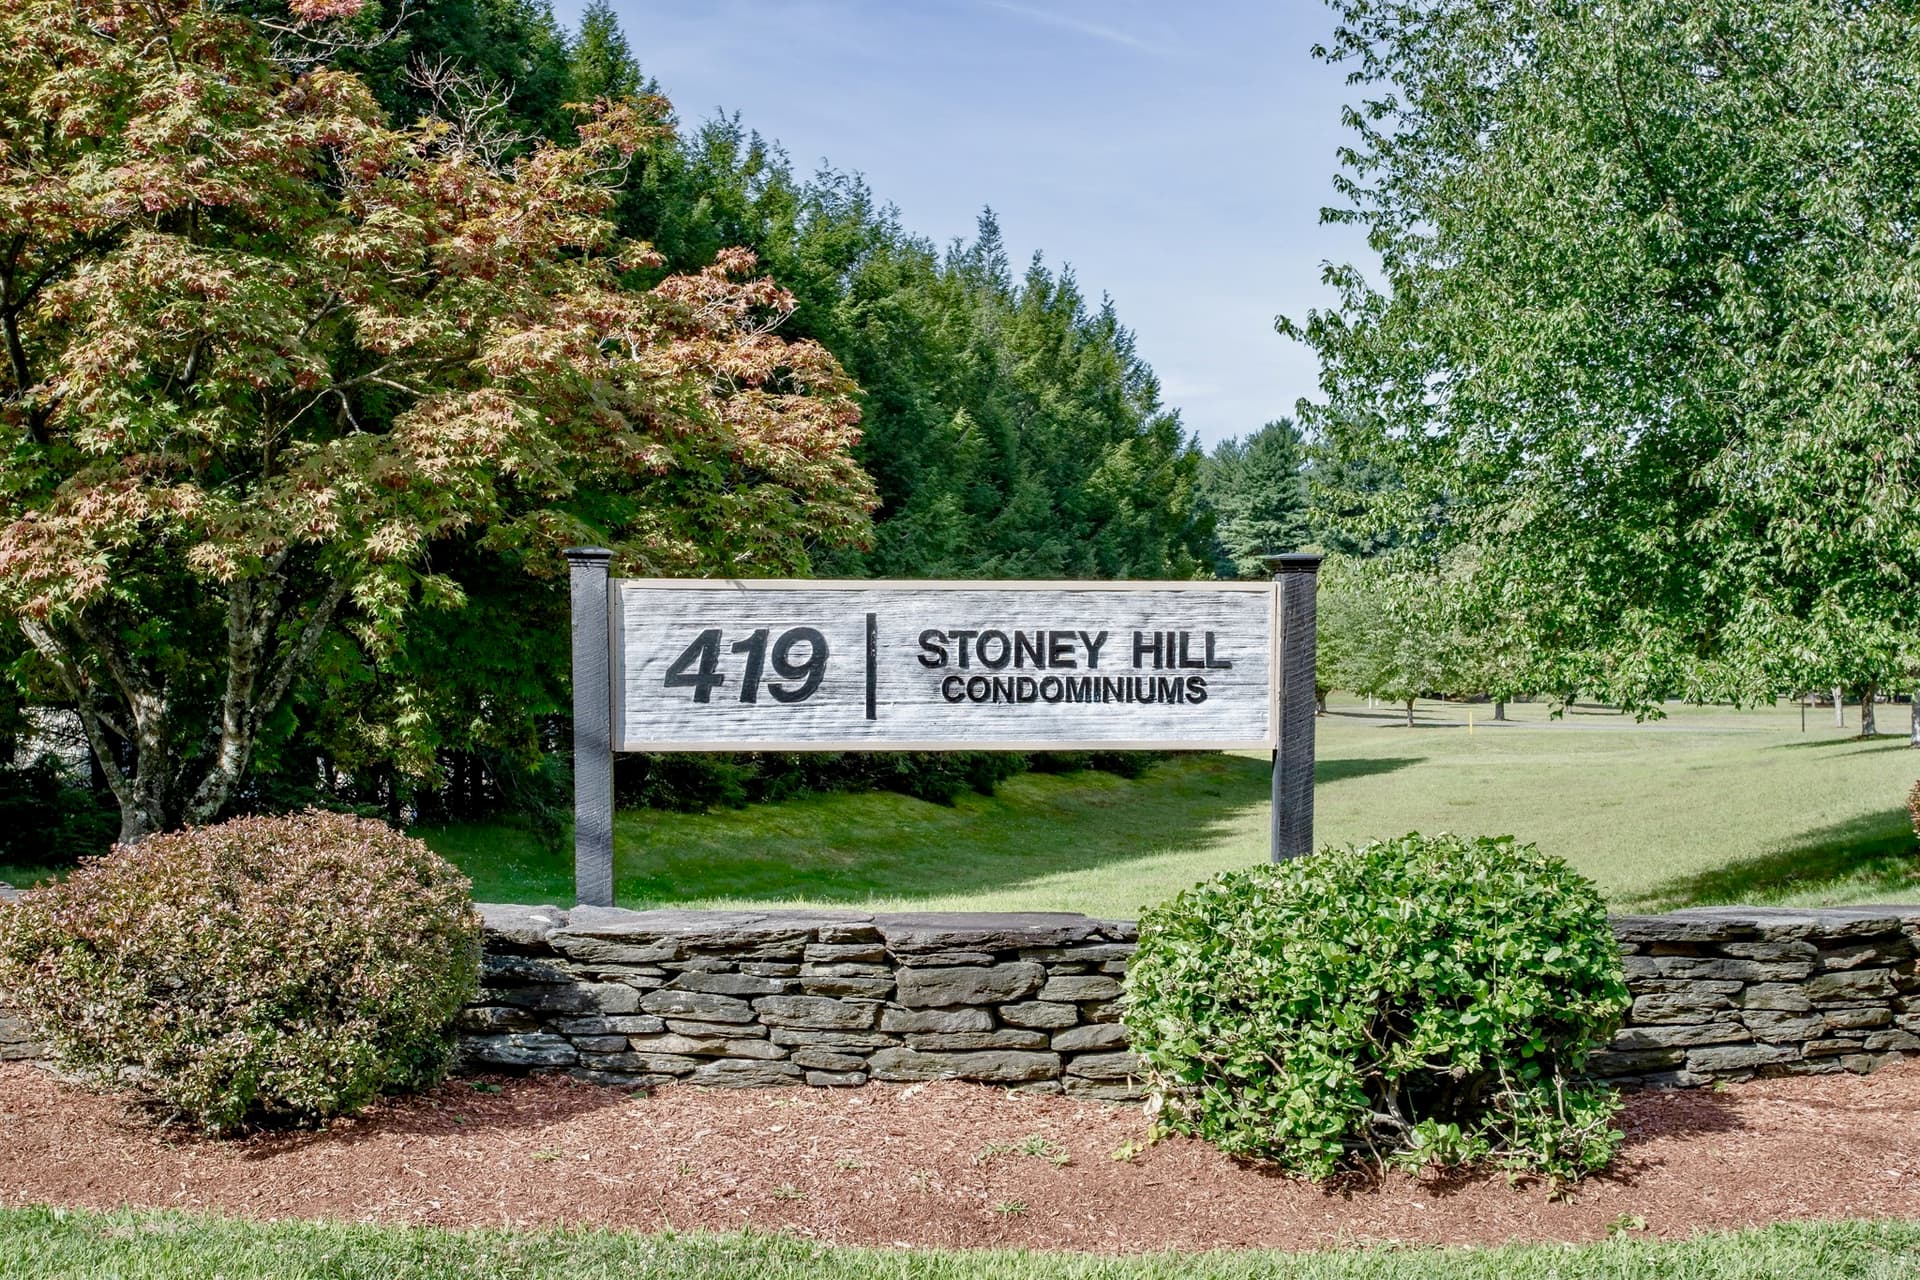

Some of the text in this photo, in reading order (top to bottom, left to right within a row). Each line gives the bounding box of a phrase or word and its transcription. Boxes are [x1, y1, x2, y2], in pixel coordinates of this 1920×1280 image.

[663, 627, 830, 704] 419
[917, 629, 1233, 670] STONEY HILL
[941, 675, 1209, 705] CONDOMINIUMS
